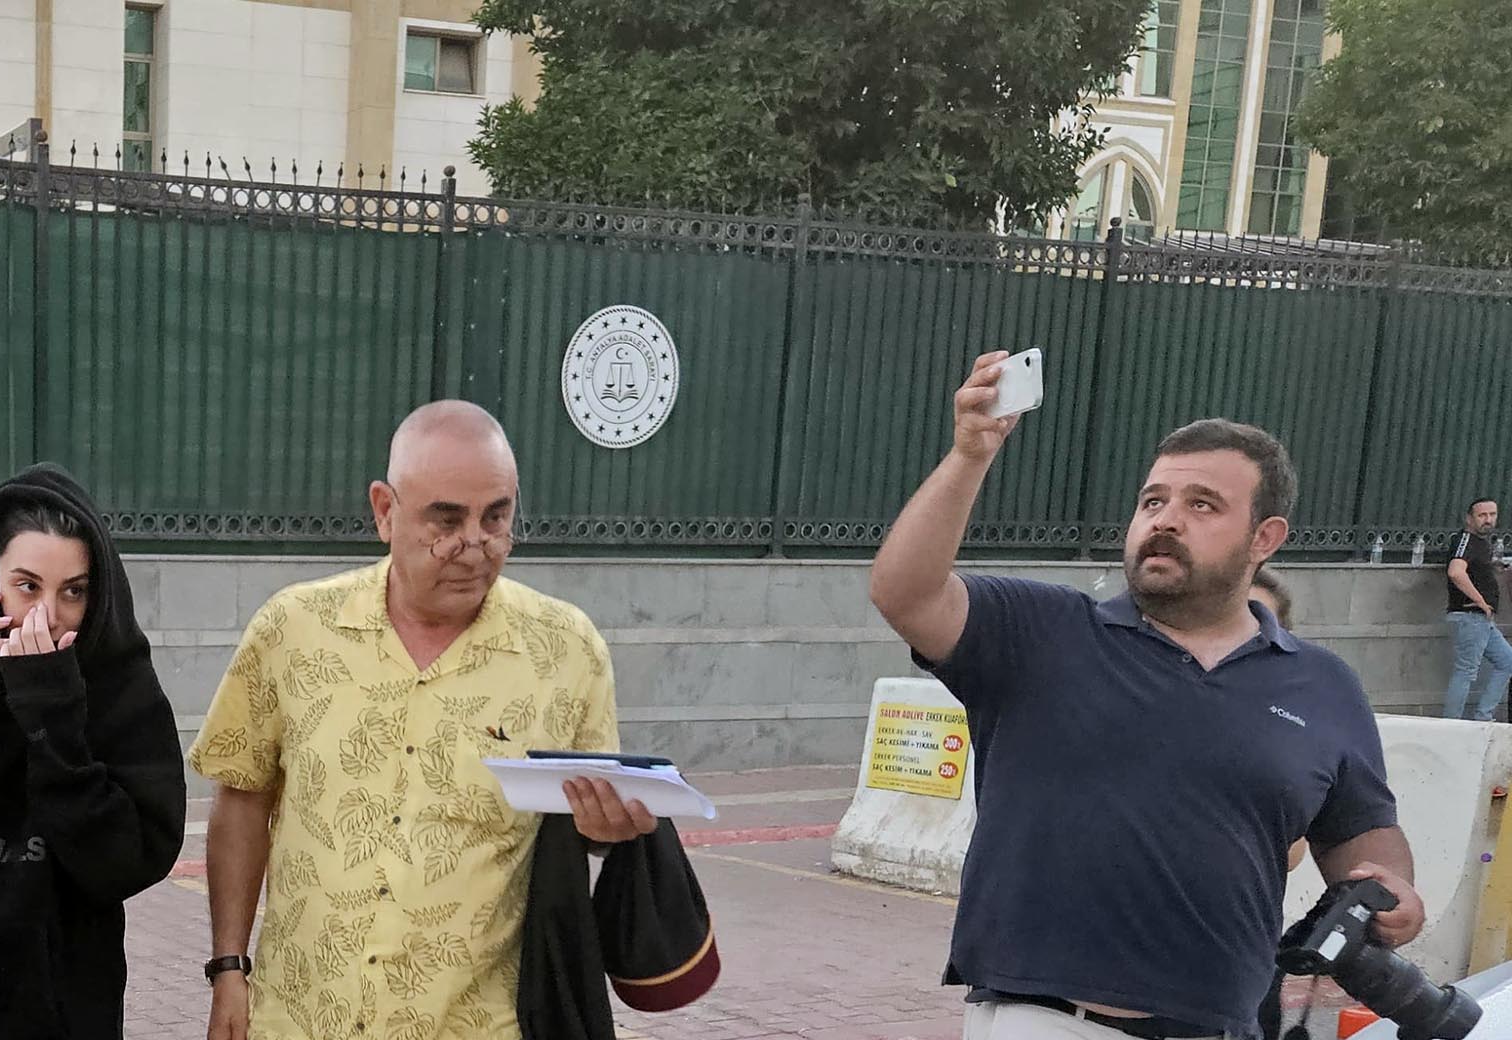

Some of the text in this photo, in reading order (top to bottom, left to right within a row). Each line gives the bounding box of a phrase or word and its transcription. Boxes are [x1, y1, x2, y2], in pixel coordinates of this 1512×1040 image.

[590, 335, 617, 362] ANTALYA
[619, 334, 646, 350] ADALET
[879, 708, 901, 719] SALON
